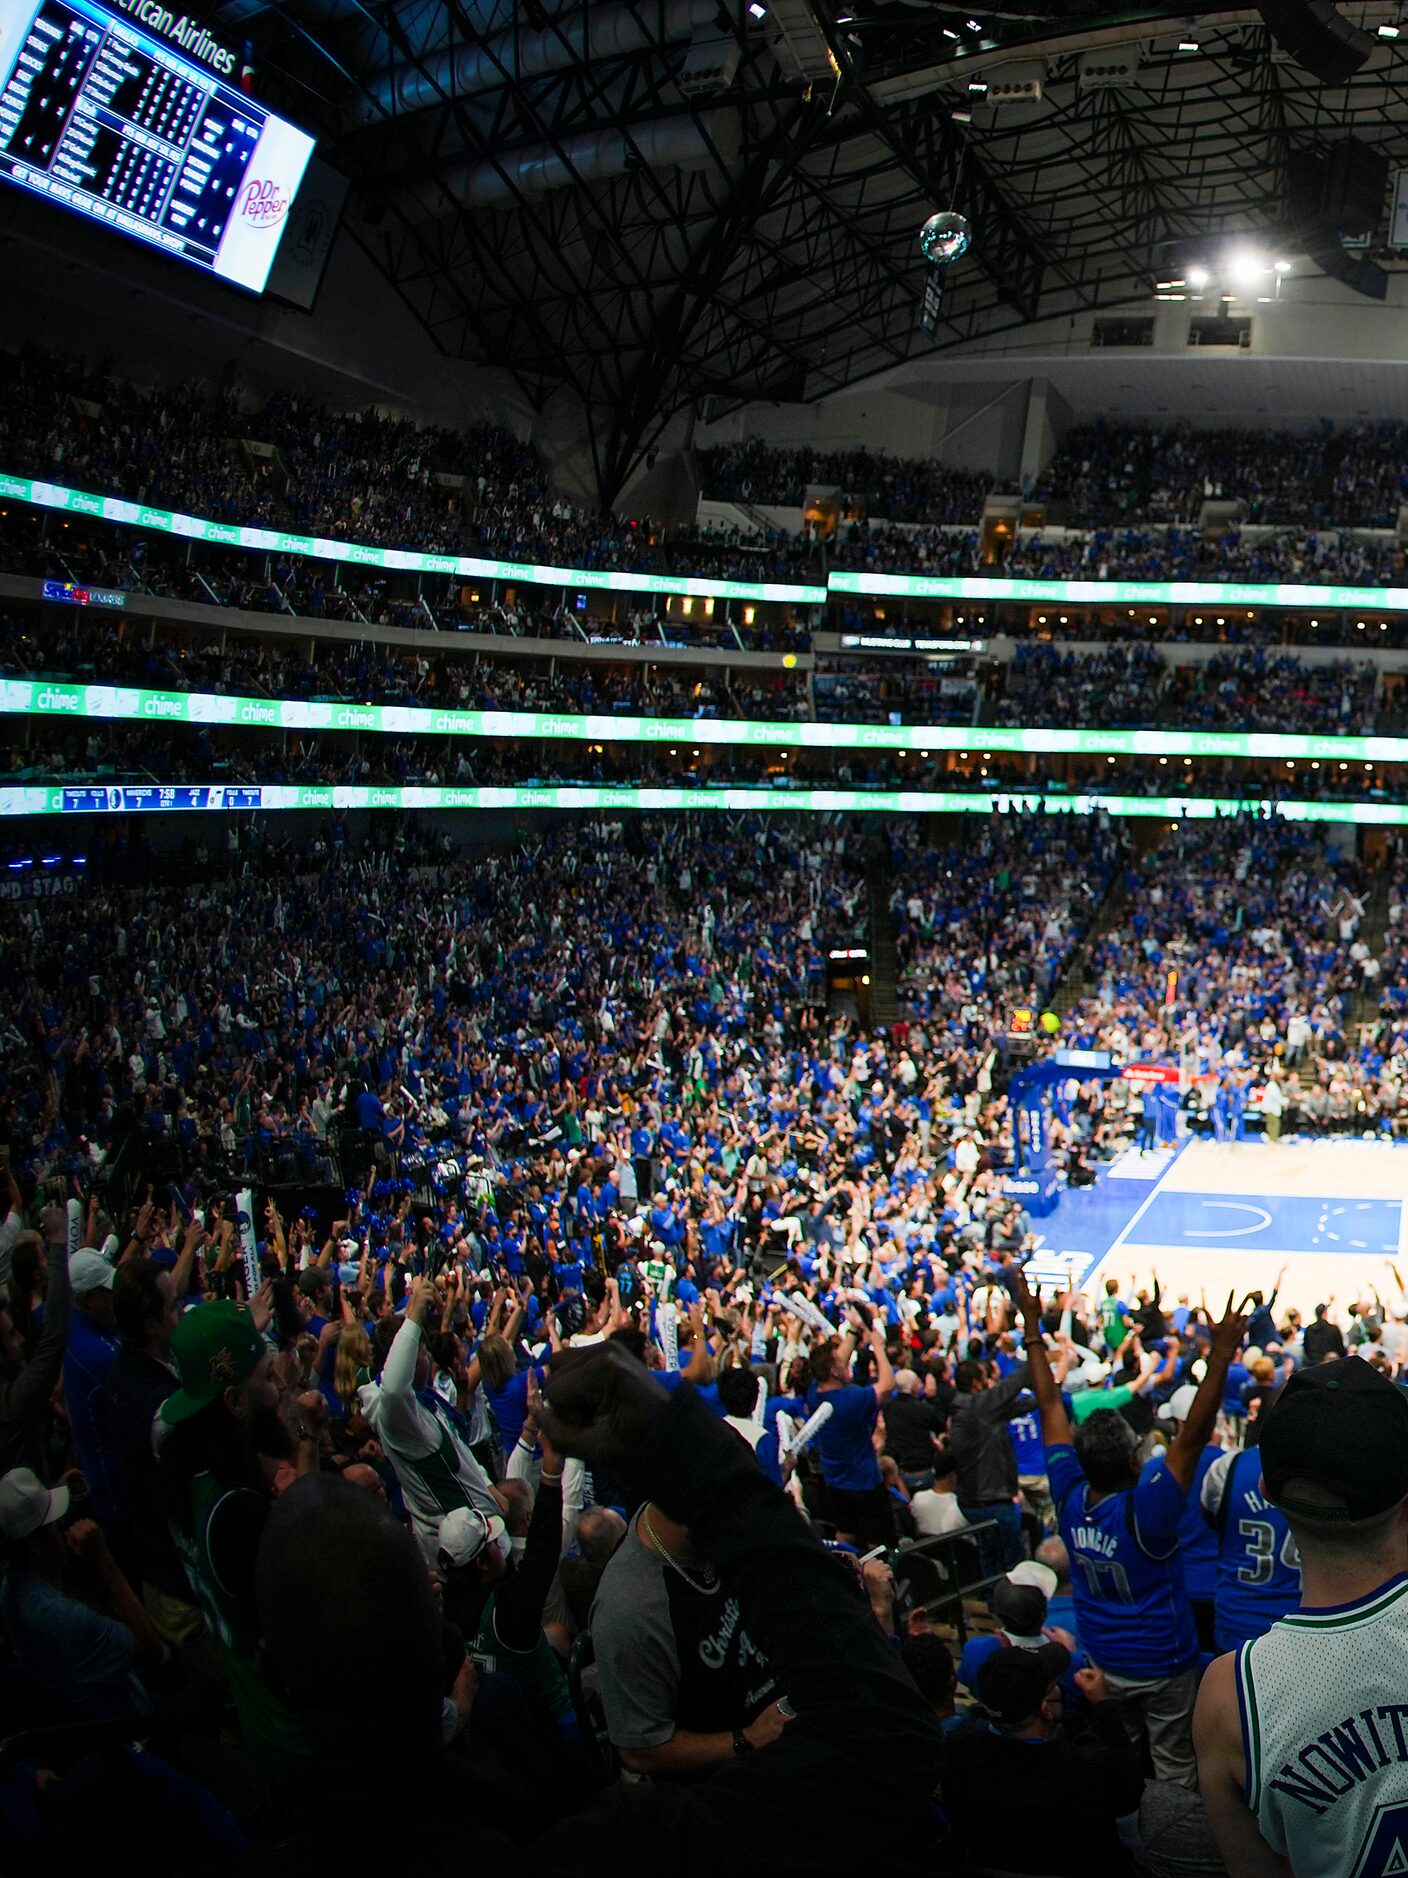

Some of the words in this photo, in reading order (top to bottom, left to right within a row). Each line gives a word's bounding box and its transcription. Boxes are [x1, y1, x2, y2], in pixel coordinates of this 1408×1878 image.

[169, 16, 236, 74] Airlines
[259, 180, 279, 200] Dr
[240, 180, 287, 220] Pepper
[71, 495, 98, 513] chime
[141, 510, 169, 528] chime
[207, 526, 236, 542] chime
[281, 536, 308, 552] chime
[353, 548, 380, 564] chime
[426, 557, 456, 572] chime
[502, 563, 529, 578] chime
[576, 573, 604, 586] chime
[654, 578, 682, 591] chime
[730, 584, 758, 597] chime
[38, 688, 78, 710] chime
[145, 696, 181, 716] chime
[241, 703, 274, 722] chime
[338, 708, 374, 727] chime
[436, 713, 474, 731] chime
[542, 718, 578, 734] chime
[646, 722, 686, 738] chime
[754, 726, 794, 742] chime
[864, 730, 904, 745] chime
[974, 732, 1015, 748] chime
[159, 789, 175, 799] 7:58
[191, 797, 197, 806] 4
[229, 797, 234, 806] 0
[248, 797, 252, 806] 7
[302, 790, 328, 805] chime
[372, 790, 397, 805] chime
[445, 790, 473, 806] chime
[521, 790, 552, 806] chime
[73, 799, 78, 808] 7
[95, 799, 99, 808] 1
[136, 797, 142, 808] 7
[32, 876, 77, 898] STAG
[70, 1217, 80, 1254] VOYA
[667, 1318, 678, 1368] VOYAGER
[1073, 1550, 1136, 1606] 77
